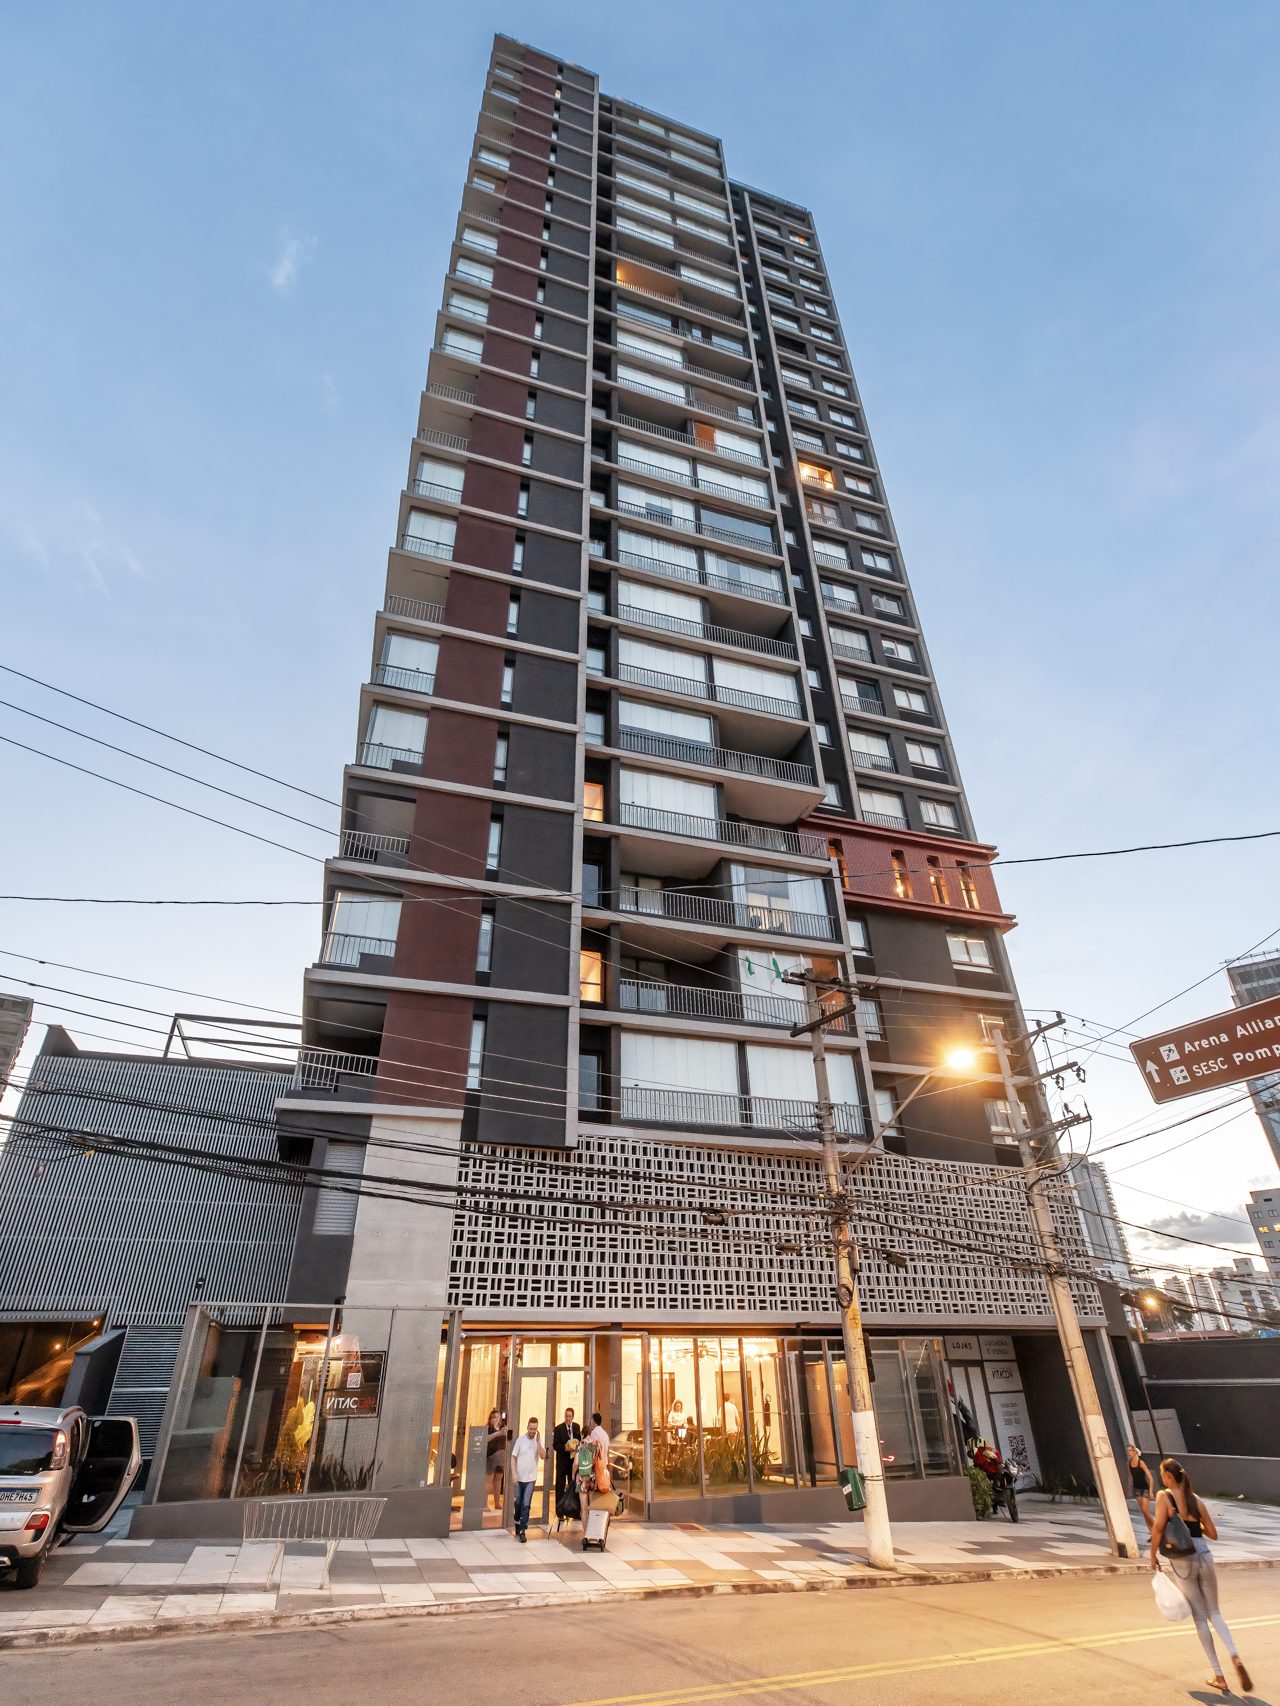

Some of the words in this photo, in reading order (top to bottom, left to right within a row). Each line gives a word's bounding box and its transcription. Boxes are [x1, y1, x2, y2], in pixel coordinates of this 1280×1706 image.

[1184, 1033, 1229, 1054] Arena
[1192, 1057, 1228, 1077] SESC
[952, 1342, 973, 1350] LOJAS
